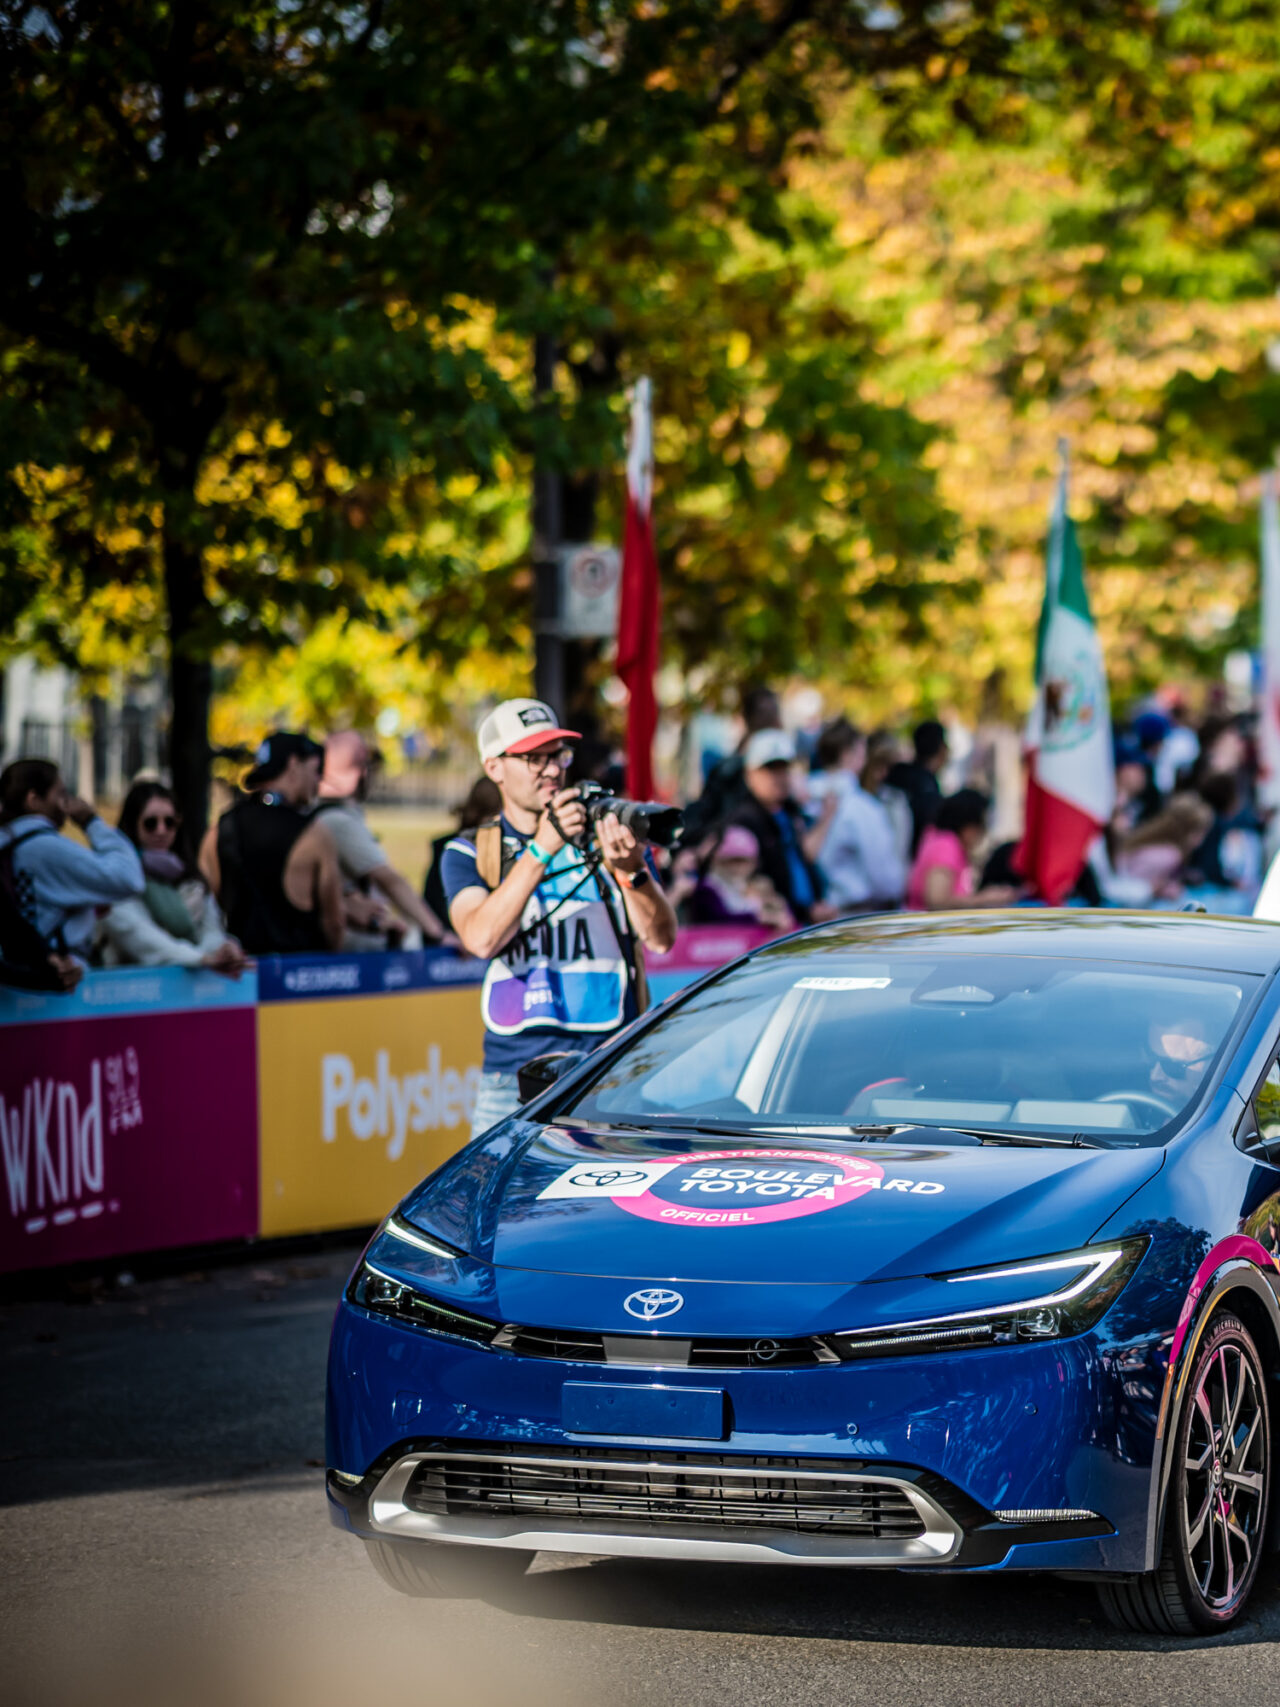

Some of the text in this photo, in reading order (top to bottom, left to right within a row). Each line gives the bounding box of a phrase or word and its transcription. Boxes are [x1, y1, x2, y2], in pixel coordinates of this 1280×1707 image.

[676, 1152, 721, 1163] FIER
[679, 1179, 835, 1200] TOYOTA
[690, 1167, 947, 1195] BOULEVARD
[660, 1208, 756, 1222] OFFICIEL
